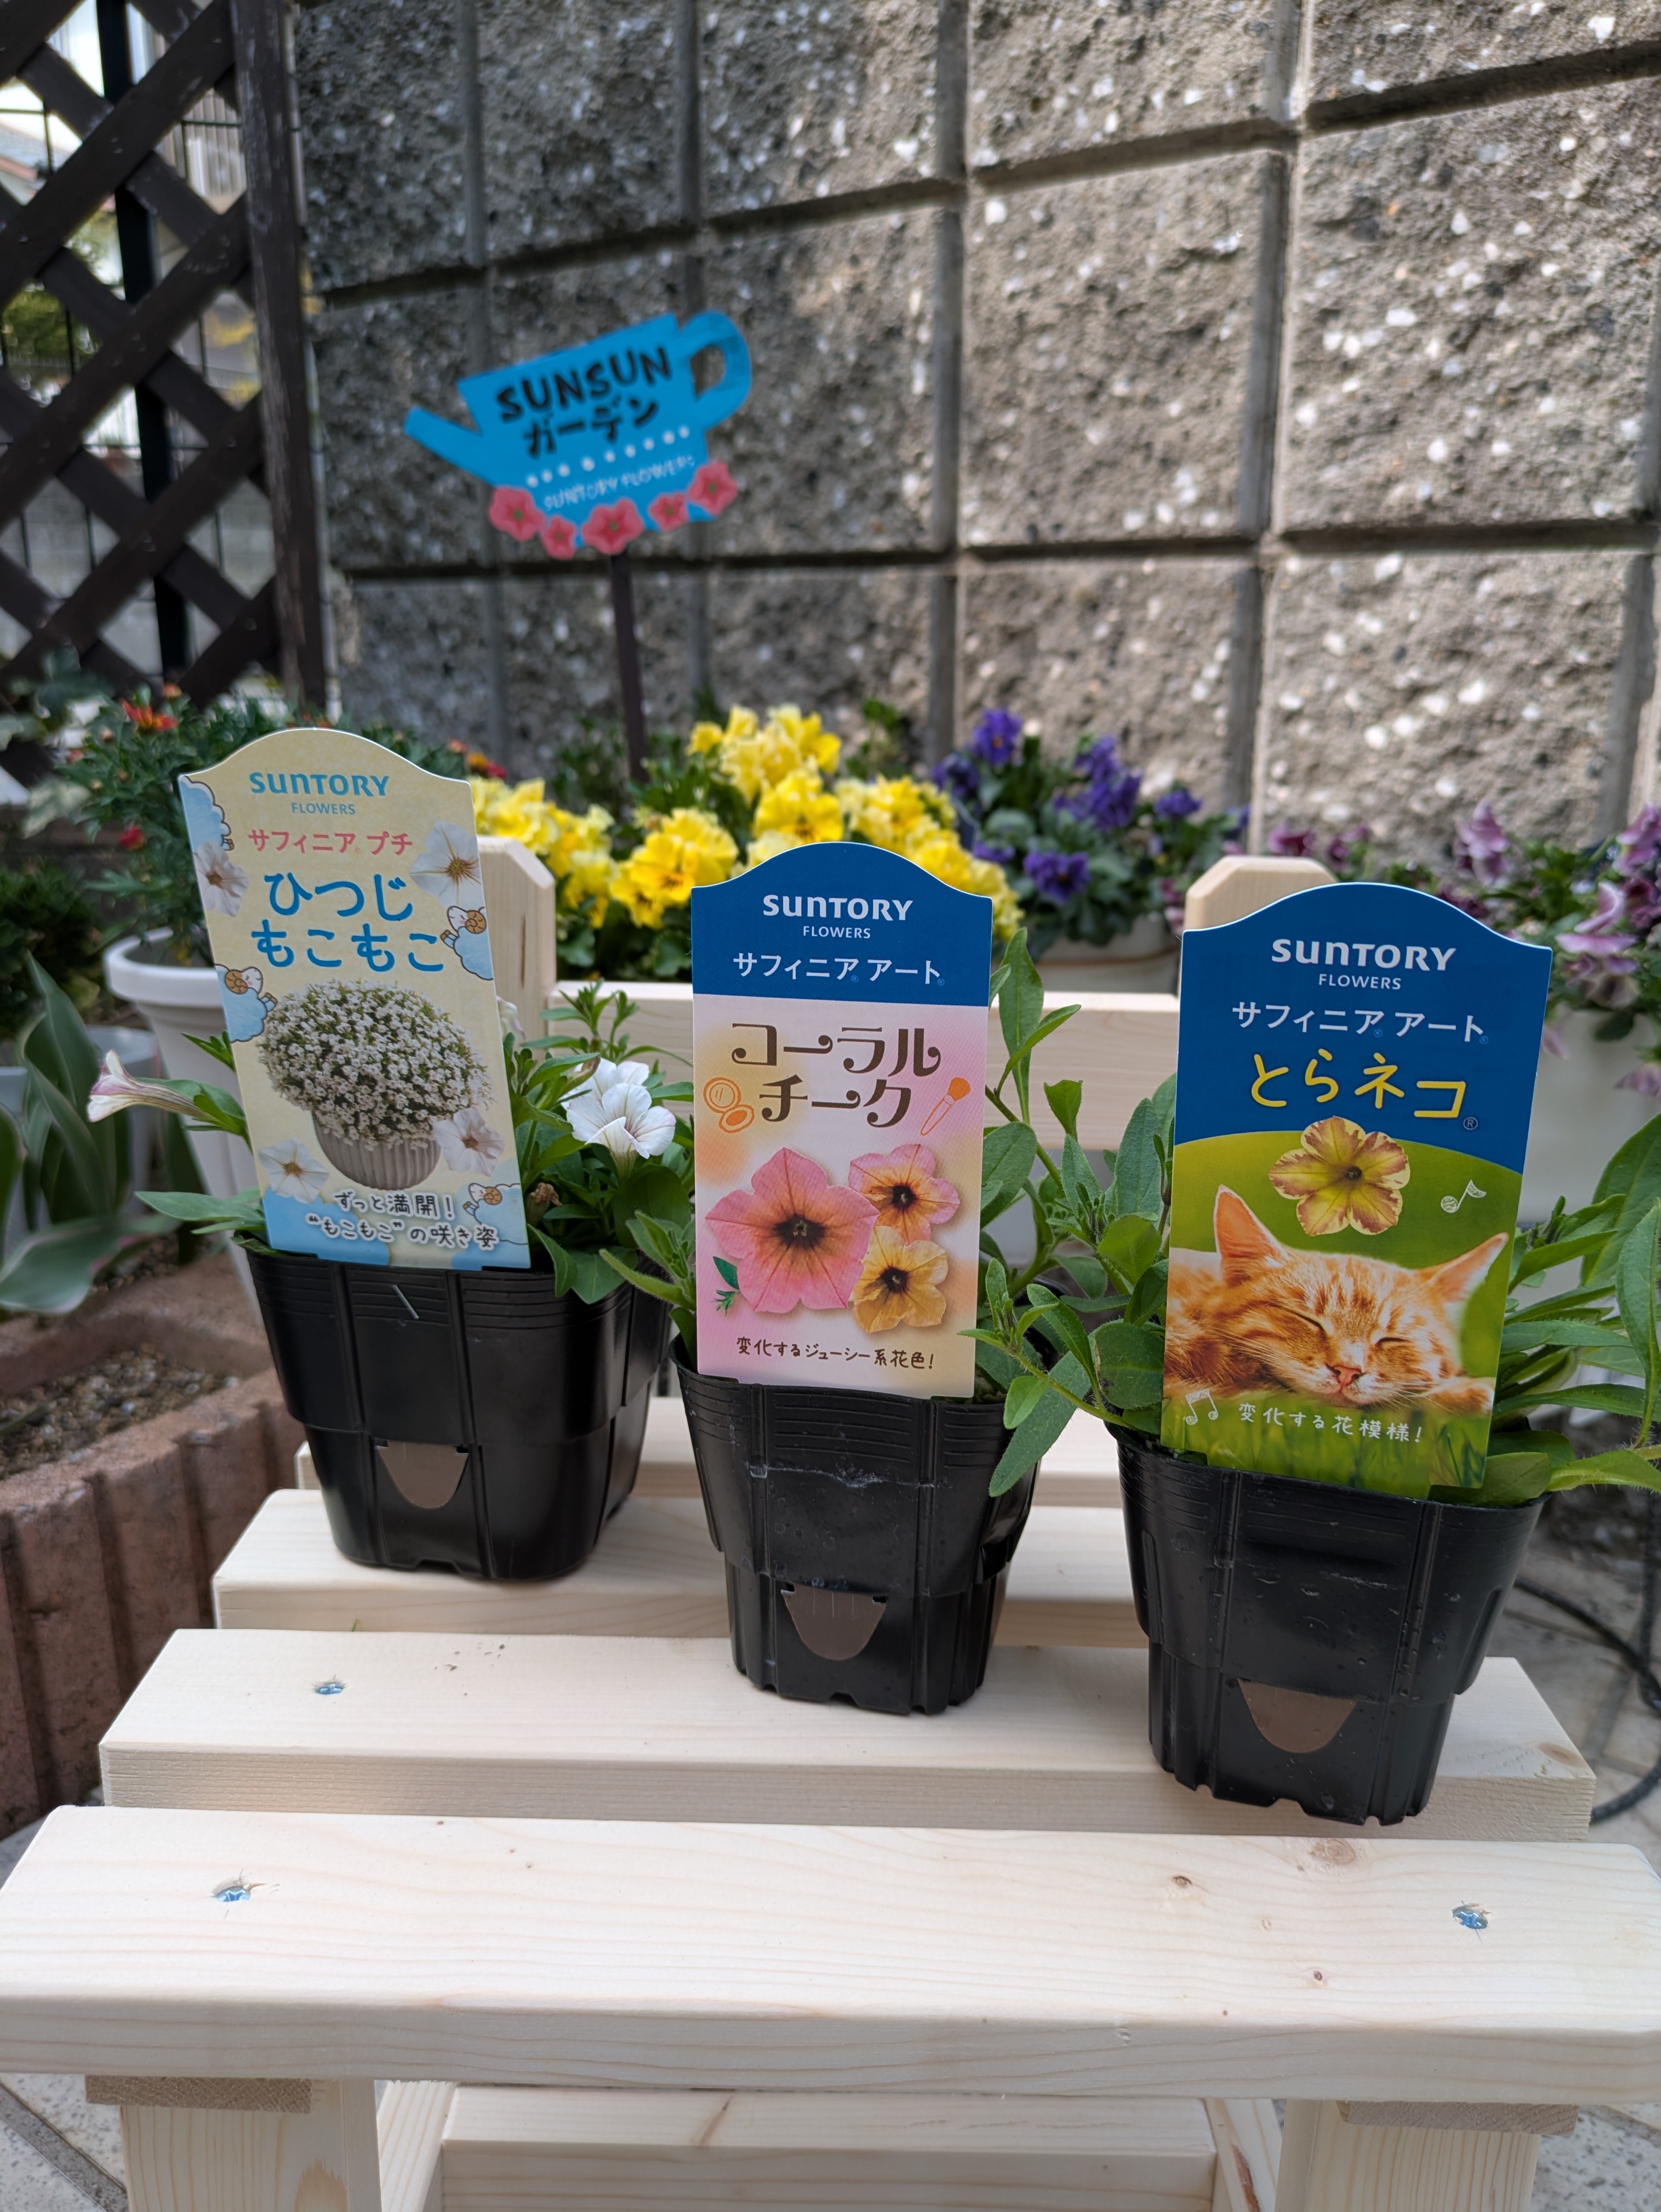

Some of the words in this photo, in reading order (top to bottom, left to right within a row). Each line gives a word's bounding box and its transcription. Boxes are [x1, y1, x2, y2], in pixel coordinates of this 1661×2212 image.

[496, 347, 672, 422] SUNSUN
[524, 397, 658, 458] ガーデン
[249, 772, 390, 796] SUNTORY
[291, 803, 355, 815] FLOWERS
[367, 831, 413, 856] プチ
[264, 873, 413, 921] ひつじ
[763, 895, 913, 921] SUNTORY
[251, 919, 444, 972] もこもこ
[803, 926, 871, 939] FLOWERS
[1271, 939, 1457, 971] SUNTORY
[1318, 973, 1402, 990] FLOWERS
[731, 1023, 941, 1077] コーラル
[759, 1074, 911, 1128] チーク
[736, 1336, 934, 1370] 変化するジューシー系花色!
[1238, 1402, 1422, 1443] 変化する花模様!
